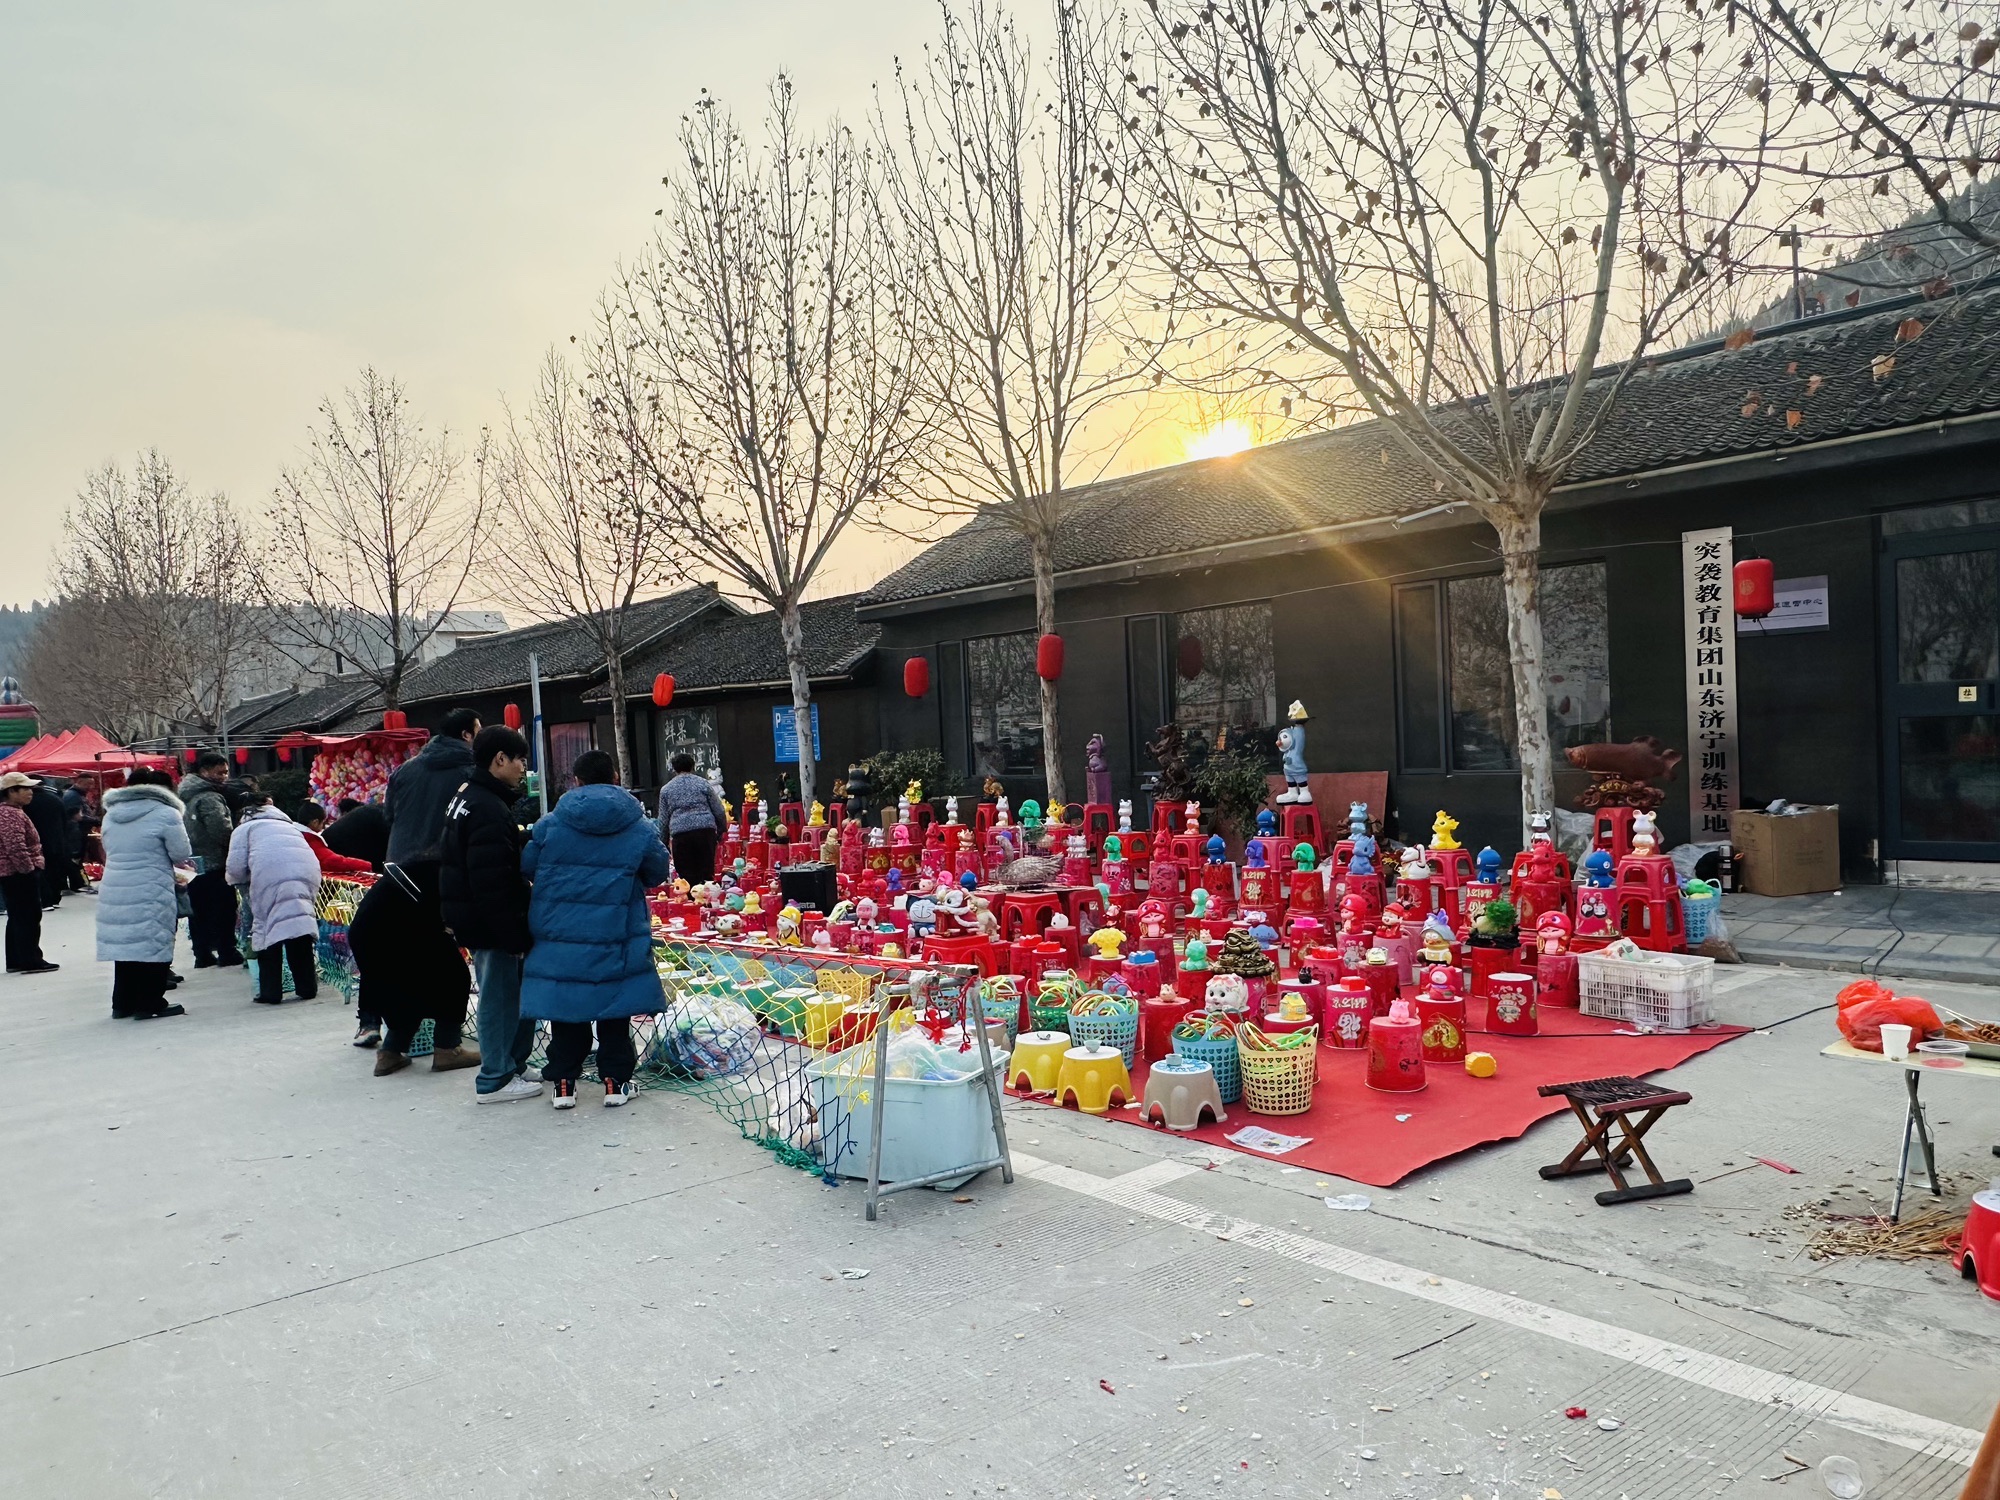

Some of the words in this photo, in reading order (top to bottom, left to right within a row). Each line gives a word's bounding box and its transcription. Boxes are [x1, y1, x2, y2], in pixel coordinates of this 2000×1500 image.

[1693, 541, 1730, 833] 突袭教育集团山东济宁训练基地
